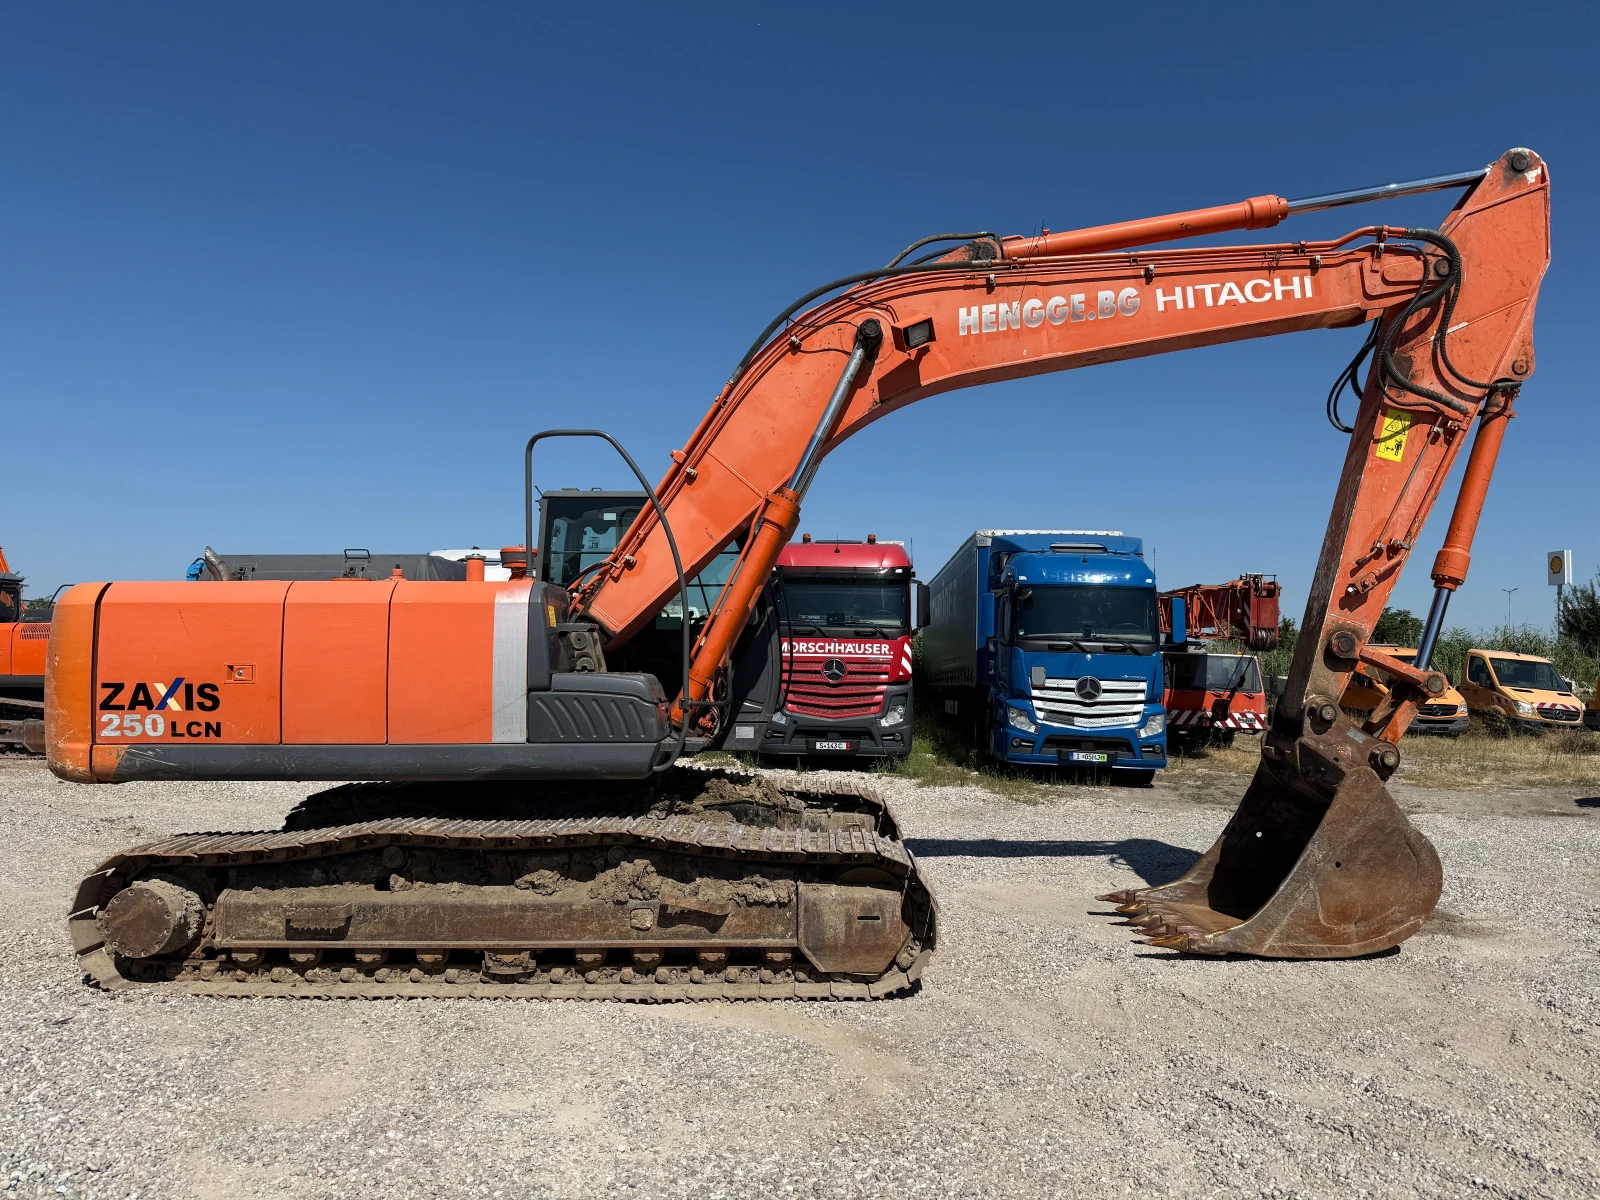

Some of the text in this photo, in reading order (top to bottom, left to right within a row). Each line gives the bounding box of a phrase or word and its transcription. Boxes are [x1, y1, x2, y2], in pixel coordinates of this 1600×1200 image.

[958, 275, 1313, 336] HENGGE.BG HITACHI
[99, 677, 221, 712] ZAXIS
[100, 713, 221, 737] 250 LCN
